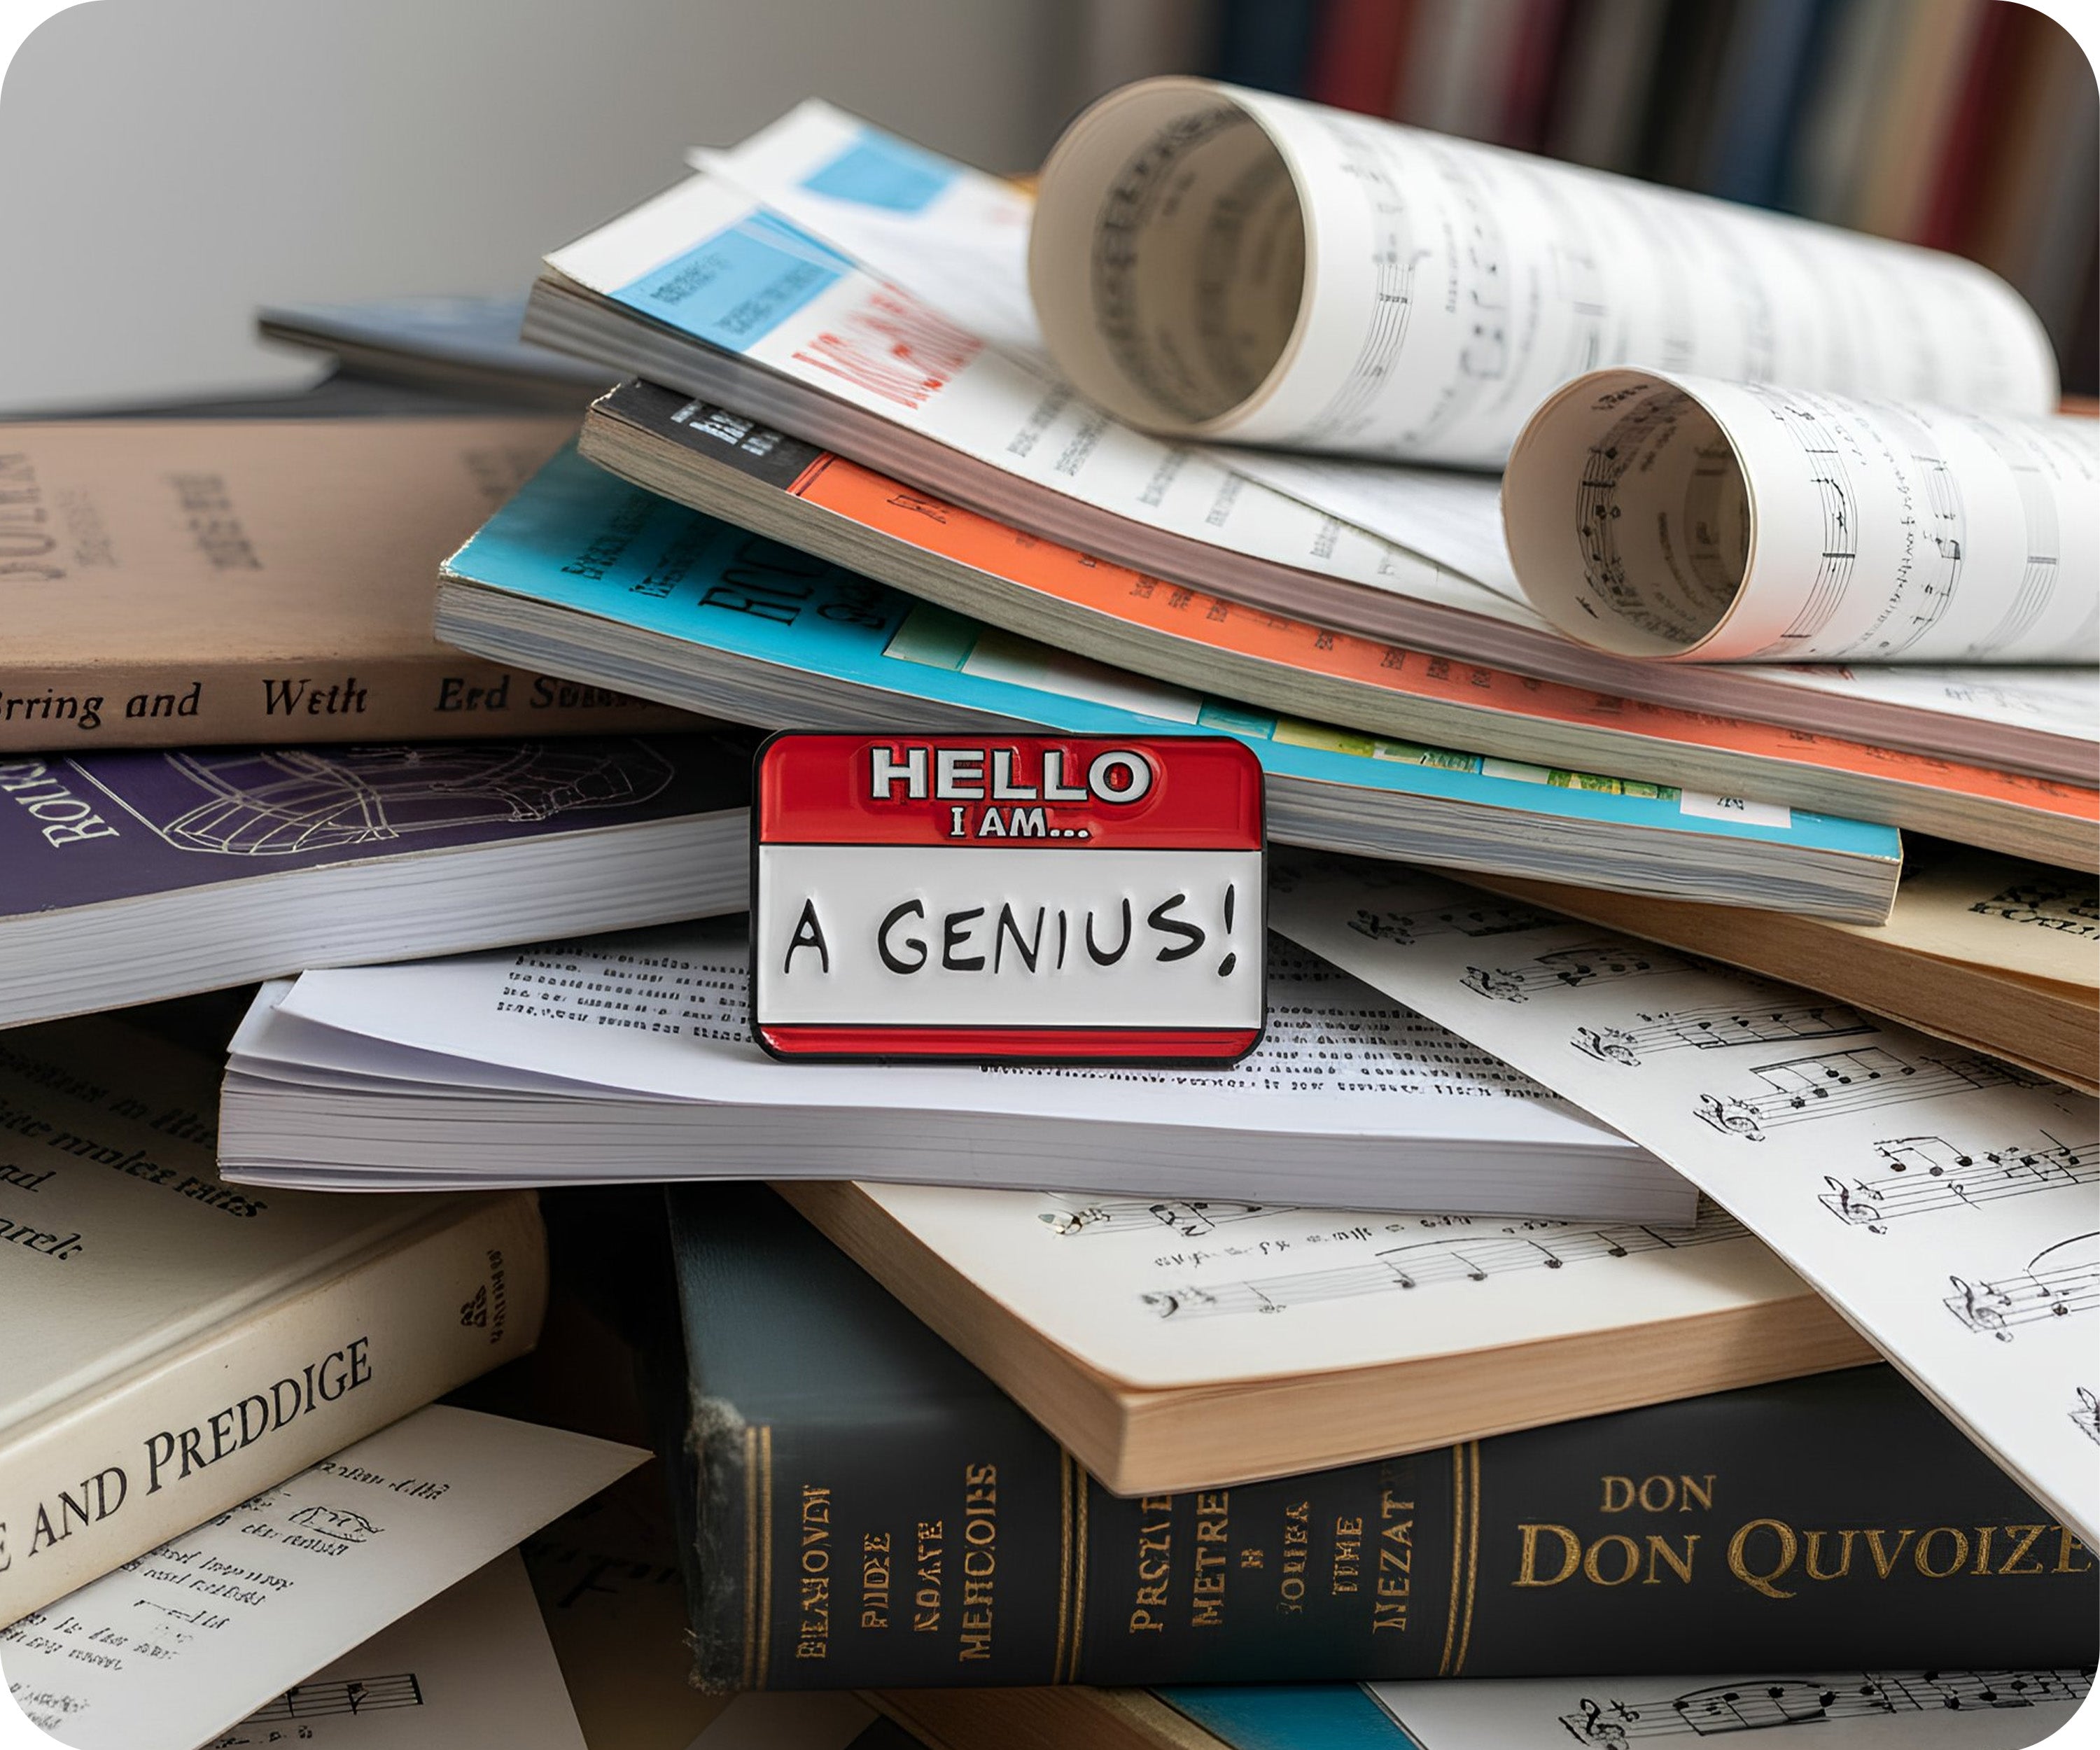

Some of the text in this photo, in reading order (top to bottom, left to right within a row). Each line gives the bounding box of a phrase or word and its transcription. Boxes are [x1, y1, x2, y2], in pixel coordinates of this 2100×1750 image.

[125, 681, 202, 719] and
[871, 747, 1150, 804] HELLO
[950, 806, 1089, 839] I AM...
[784, 883, 1236, 978] A GENIUS!
[28, 1466, 127, 1558] AND
[144, 1336, 372, 1497] PREDDIGE
[1600, 1474, 1716, 1513] DON
[1511, 1517, 2092, 1599] DON QUVOIZE
